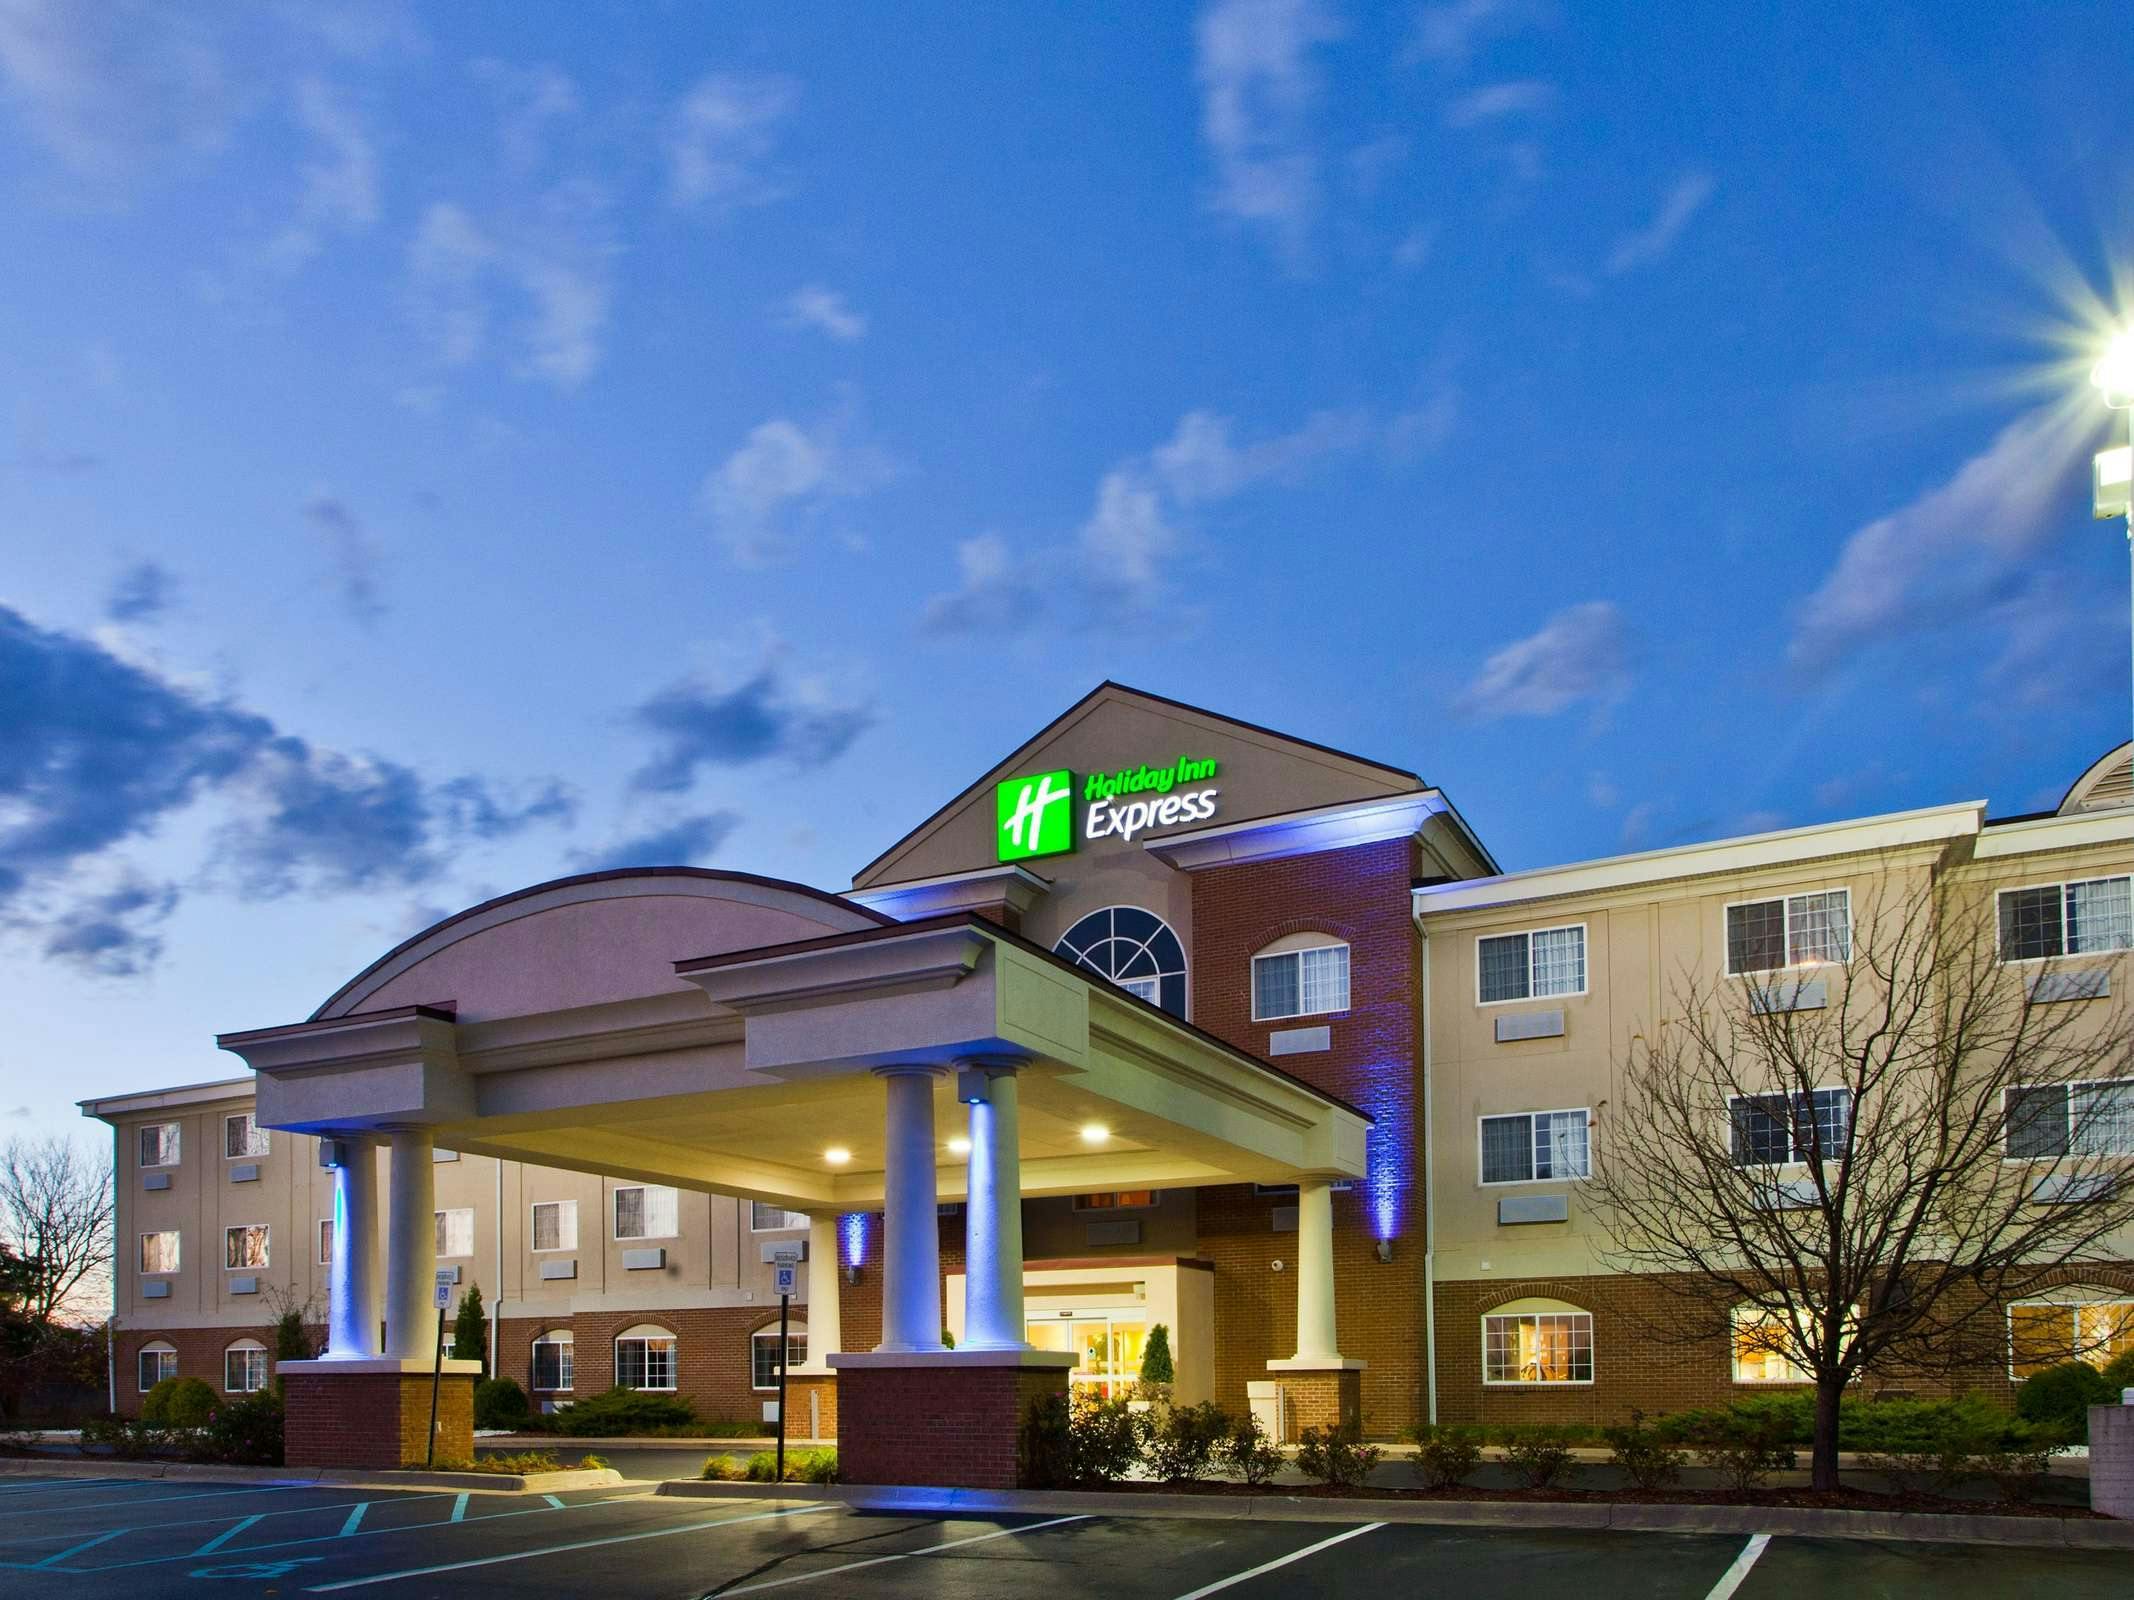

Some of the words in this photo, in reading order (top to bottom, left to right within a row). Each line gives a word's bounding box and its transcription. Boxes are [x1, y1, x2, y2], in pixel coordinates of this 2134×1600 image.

[1084, 765, 1175, 800] Holiday
[1177, 756, 1216, 783] Inn
[1086, 789, 1217, 841] Express
